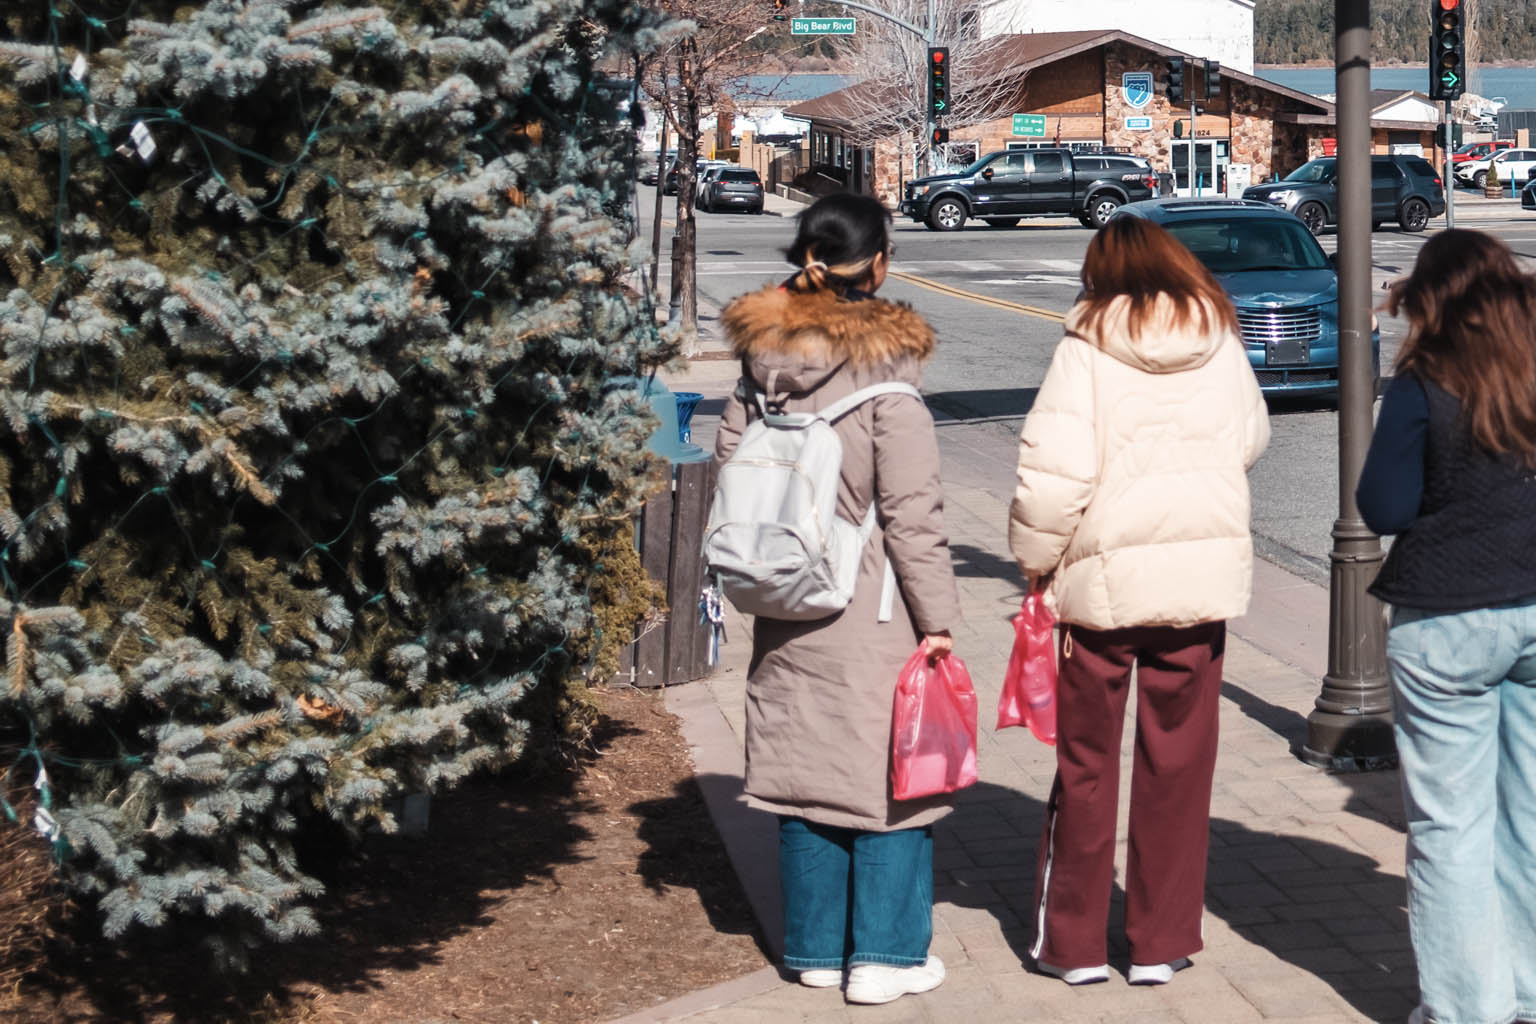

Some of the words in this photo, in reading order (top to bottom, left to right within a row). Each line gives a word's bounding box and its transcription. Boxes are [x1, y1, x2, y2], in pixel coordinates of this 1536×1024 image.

[795, 21, 809, 32] Big
[811, 21, 831, 30] Bear
[833, 21, 853, 30] Blvd
